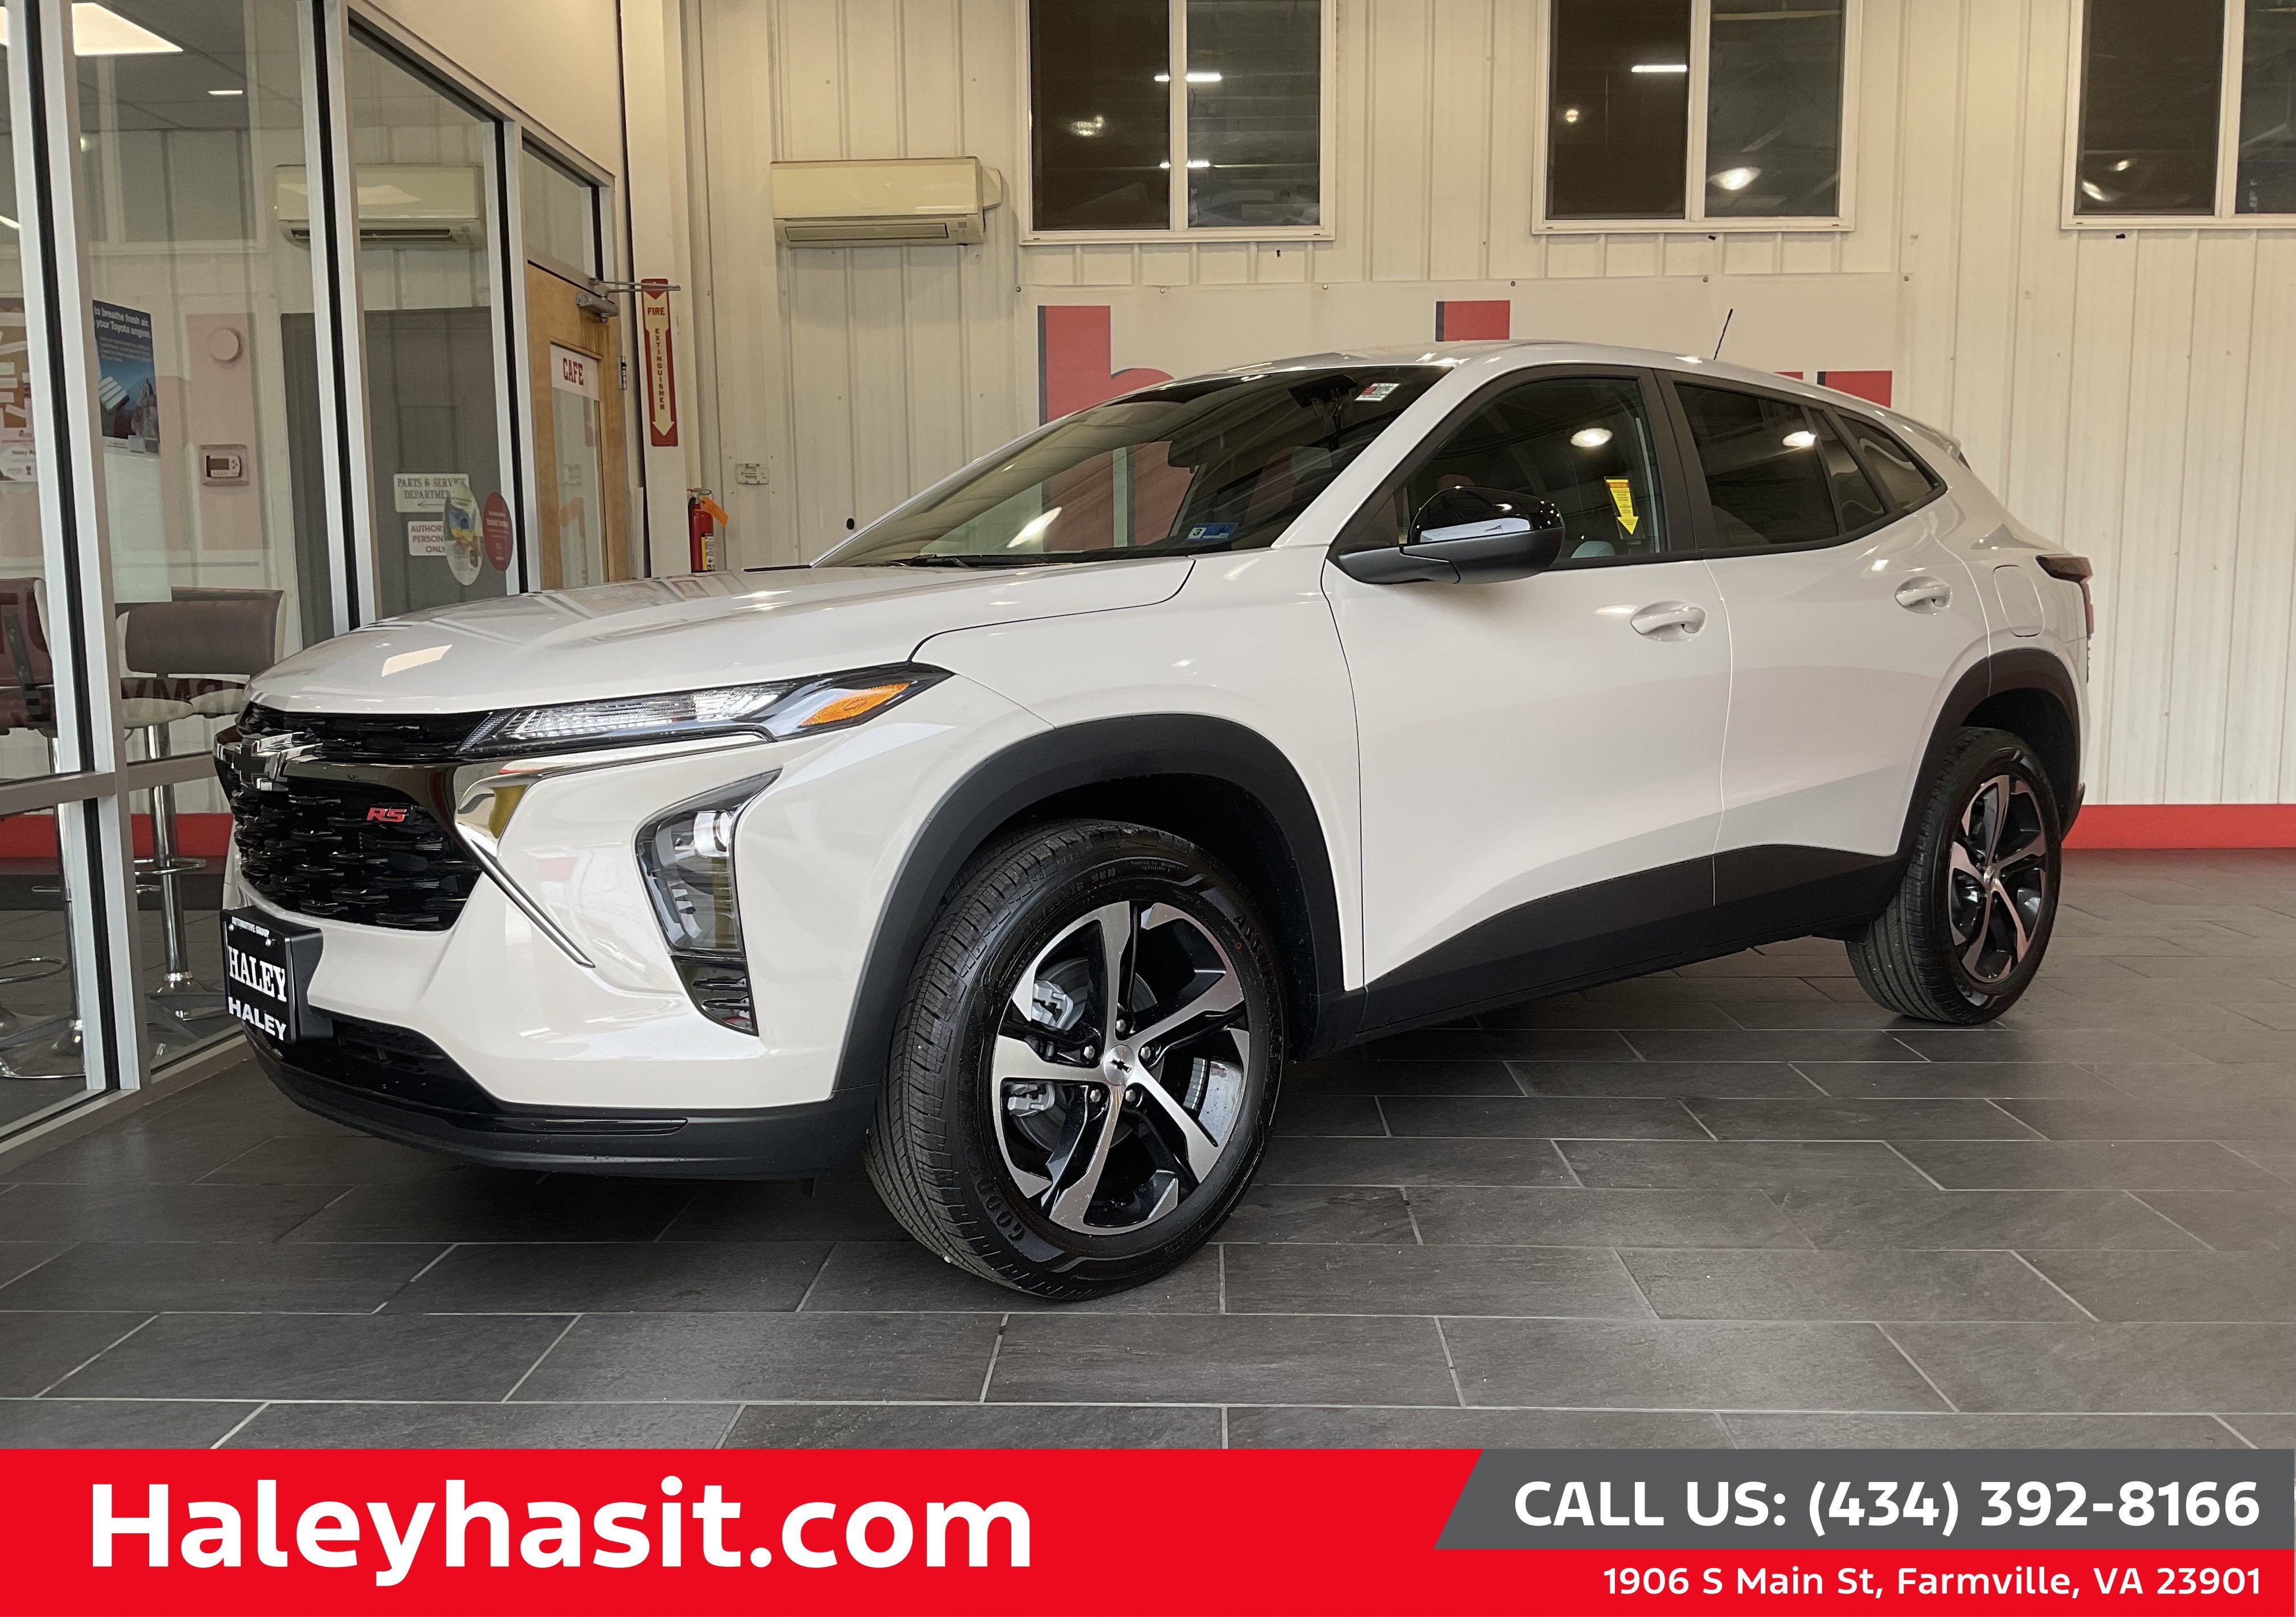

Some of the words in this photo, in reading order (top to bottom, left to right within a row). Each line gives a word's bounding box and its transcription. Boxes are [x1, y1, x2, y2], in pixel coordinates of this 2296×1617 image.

[101, 307, 125, 322] breathe
[125, 313, 140, 326] fresh
[647, 307, 666, 316] FIRE
[96, 319, 110, 329] your
[110, 321, 130, 333] Toyota
[563, 357, 584, 386] CAFE
[655, 328, 665, 410] EXTINGUISHER
[397, 478, 423, 487] PARTS
[425, 478, 430, 487] &
[366, 807, 407, 823] RS
[228, 945, 287, 1002] HALEY
[228, 996, 286, 1041] HALEY
